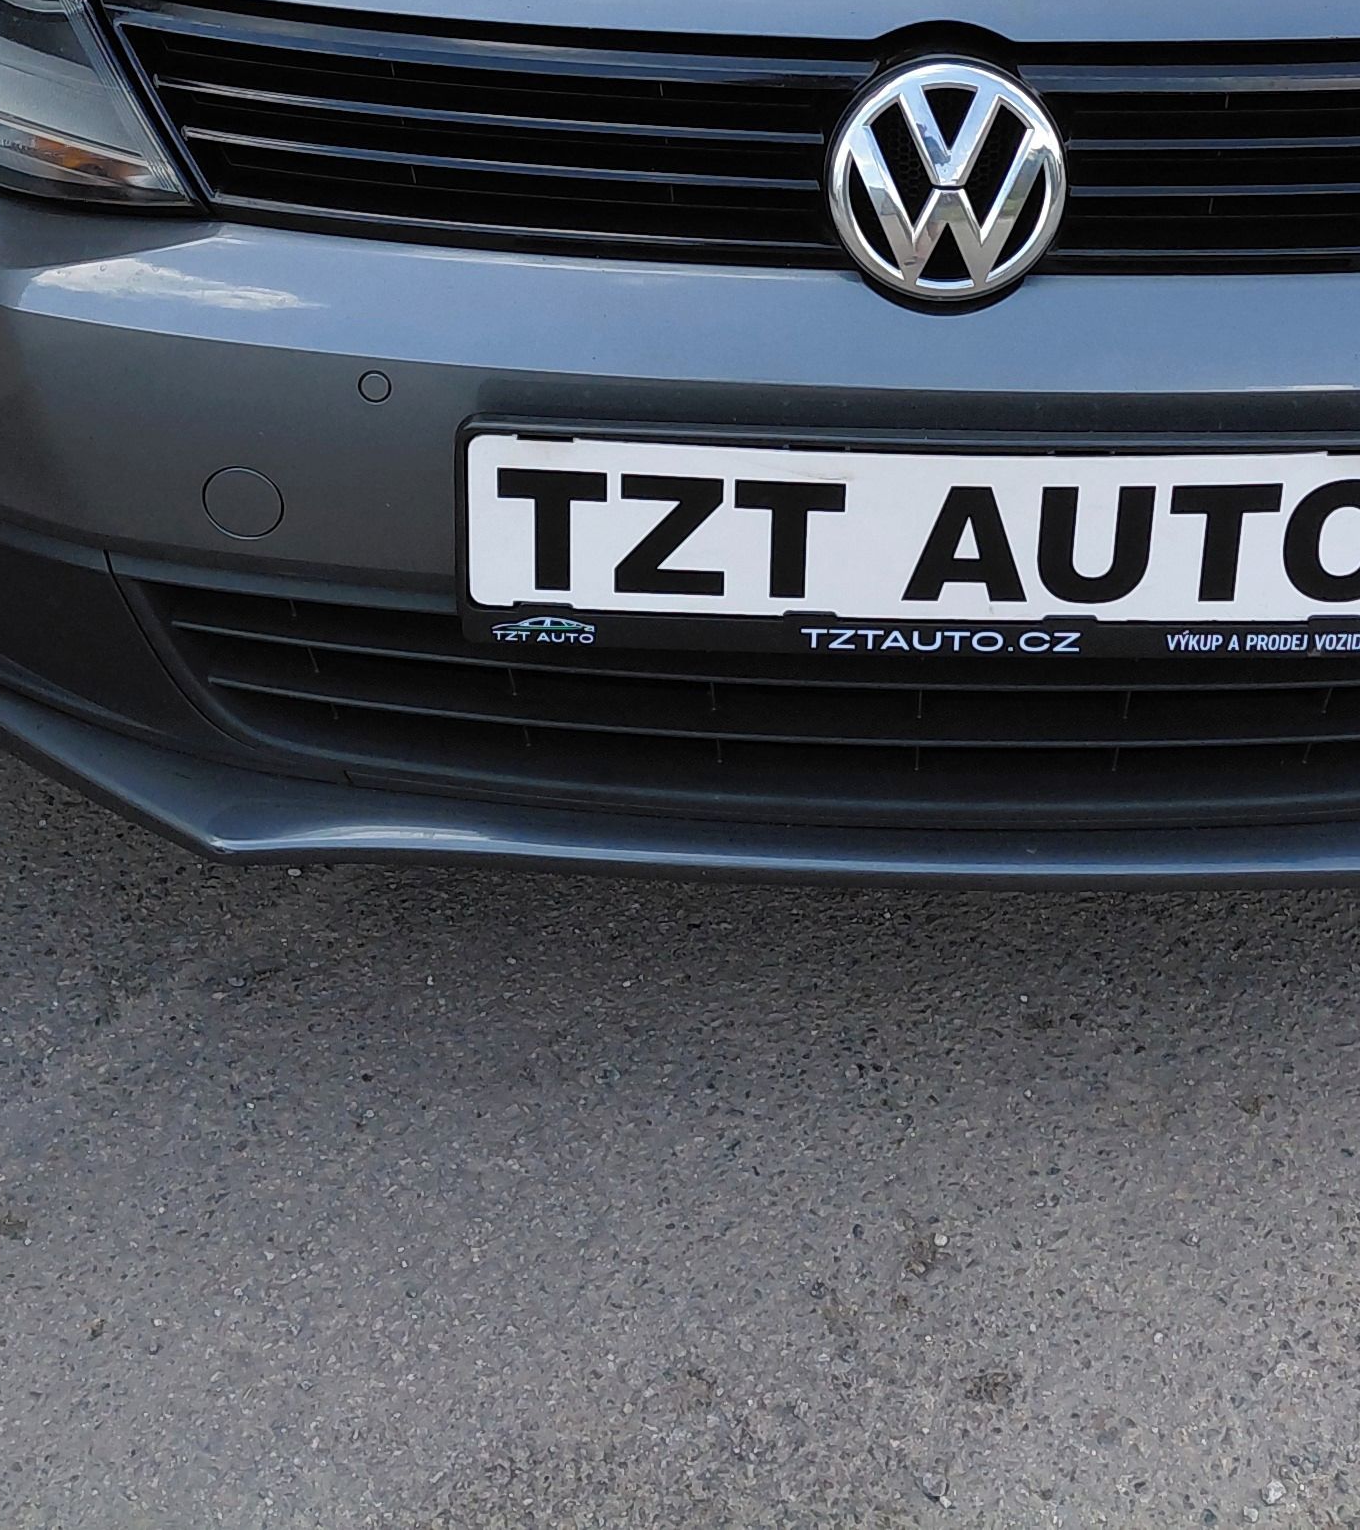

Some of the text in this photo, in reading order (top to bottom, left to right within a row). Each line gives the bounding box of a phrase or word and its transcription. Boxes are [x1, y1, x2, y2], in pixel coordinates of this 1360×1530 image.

[496, 467, 846, 599] TZT
[492, 630, 594, 644] TZT AUTO
[800, 628, 1081, 652] TZTAUTO.CZ
[1166, 630, 1223, 651] VÝKUP
[1227, 634, 1240, 651] A
[1245, 634, 1309, 651] PRODEJ
